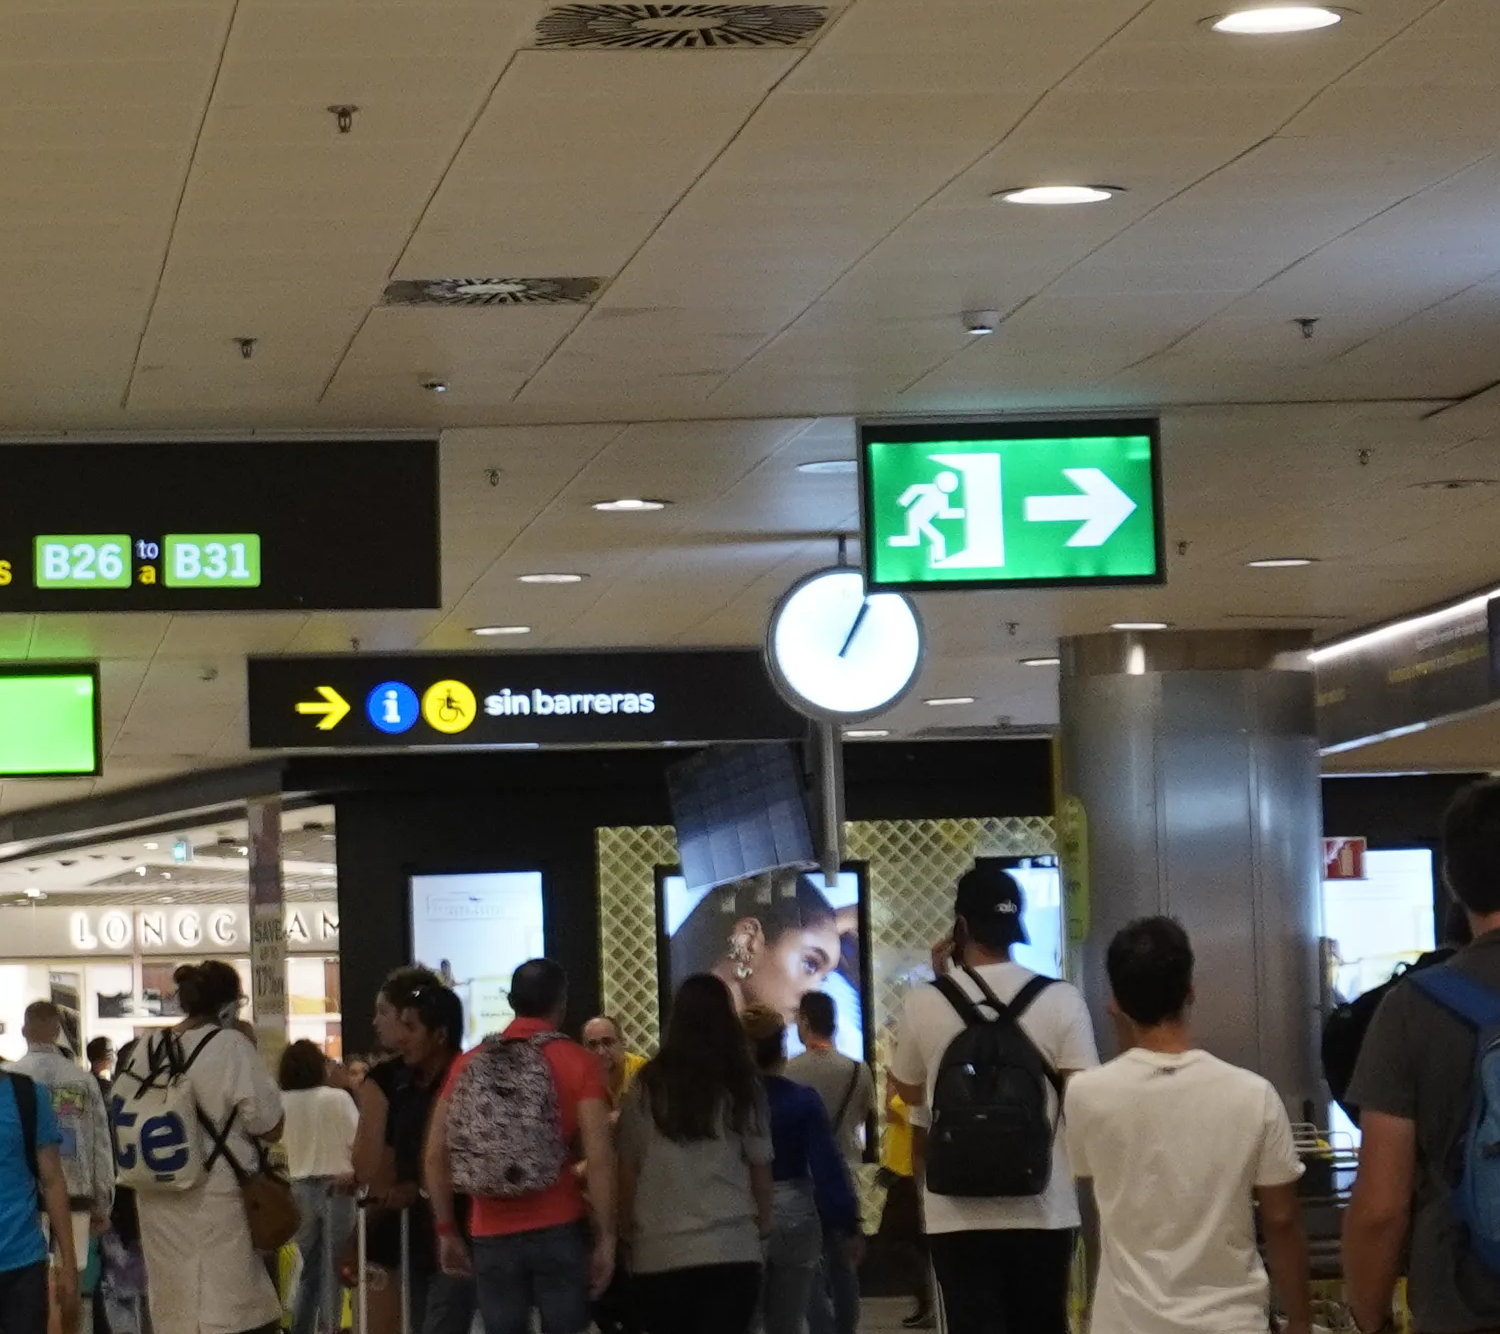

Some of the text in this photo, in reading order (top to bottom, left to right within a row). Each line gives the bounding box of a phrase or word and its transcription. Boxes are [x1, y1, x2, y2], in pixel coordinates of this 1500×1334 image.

[44, 542, 251, 585] B26 a B31
[137, 539, 159, 561] to
[484, 688, 655, 716] sin barreras
